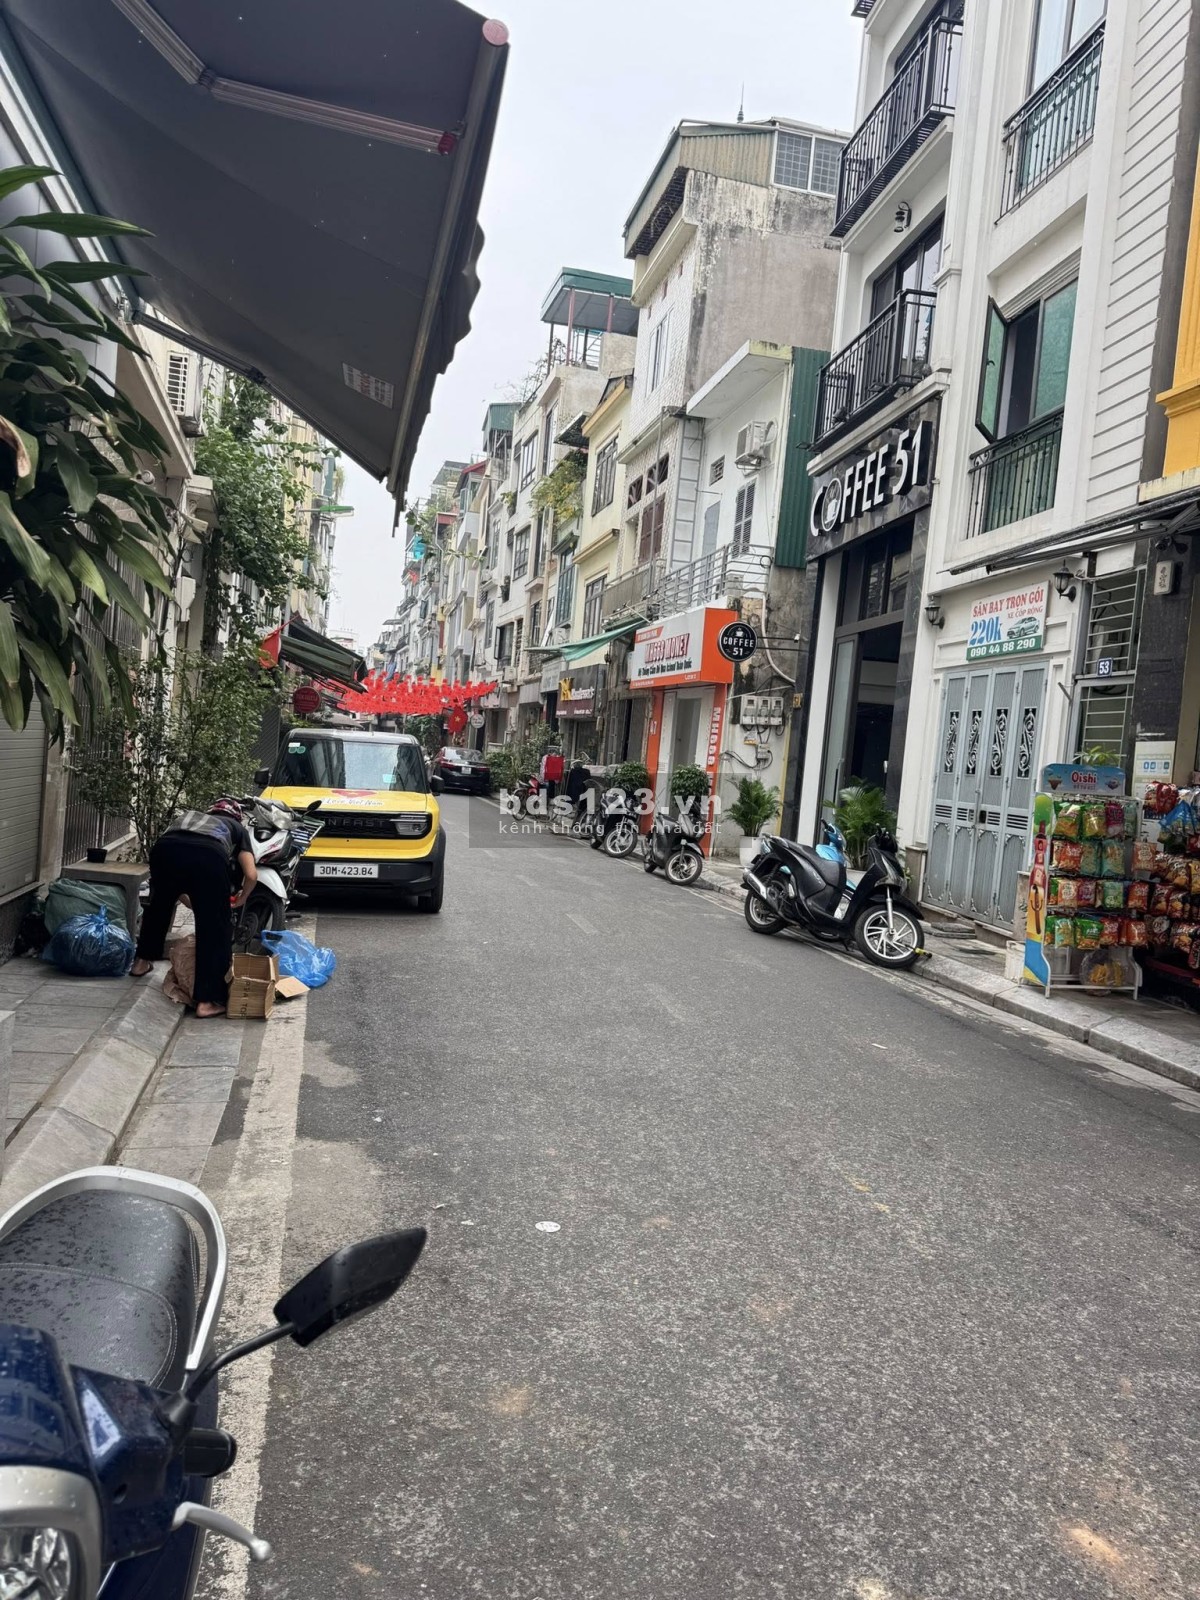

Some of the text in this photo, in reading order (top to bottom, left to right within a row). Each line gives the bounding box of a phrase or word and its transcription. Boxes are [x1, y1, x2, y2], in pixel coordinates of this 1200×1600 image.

[811, 420, 926, 537] COFFEE 51
[989, 598, 1005, 614] BAY
[1029, 586, 1044, 604] GÓI
[1007, 610, 1015, 619] XE
[665, 633, 690, 660] MONEY
[723, 637, 754, 648] COFFEE
[970, 638, 1035, 657] 090 44 88 290
[732, 647, 744, 656] 51
[1099, 661, 1109, 674] 53
[1071, 771, 1097, 783] Oishi
